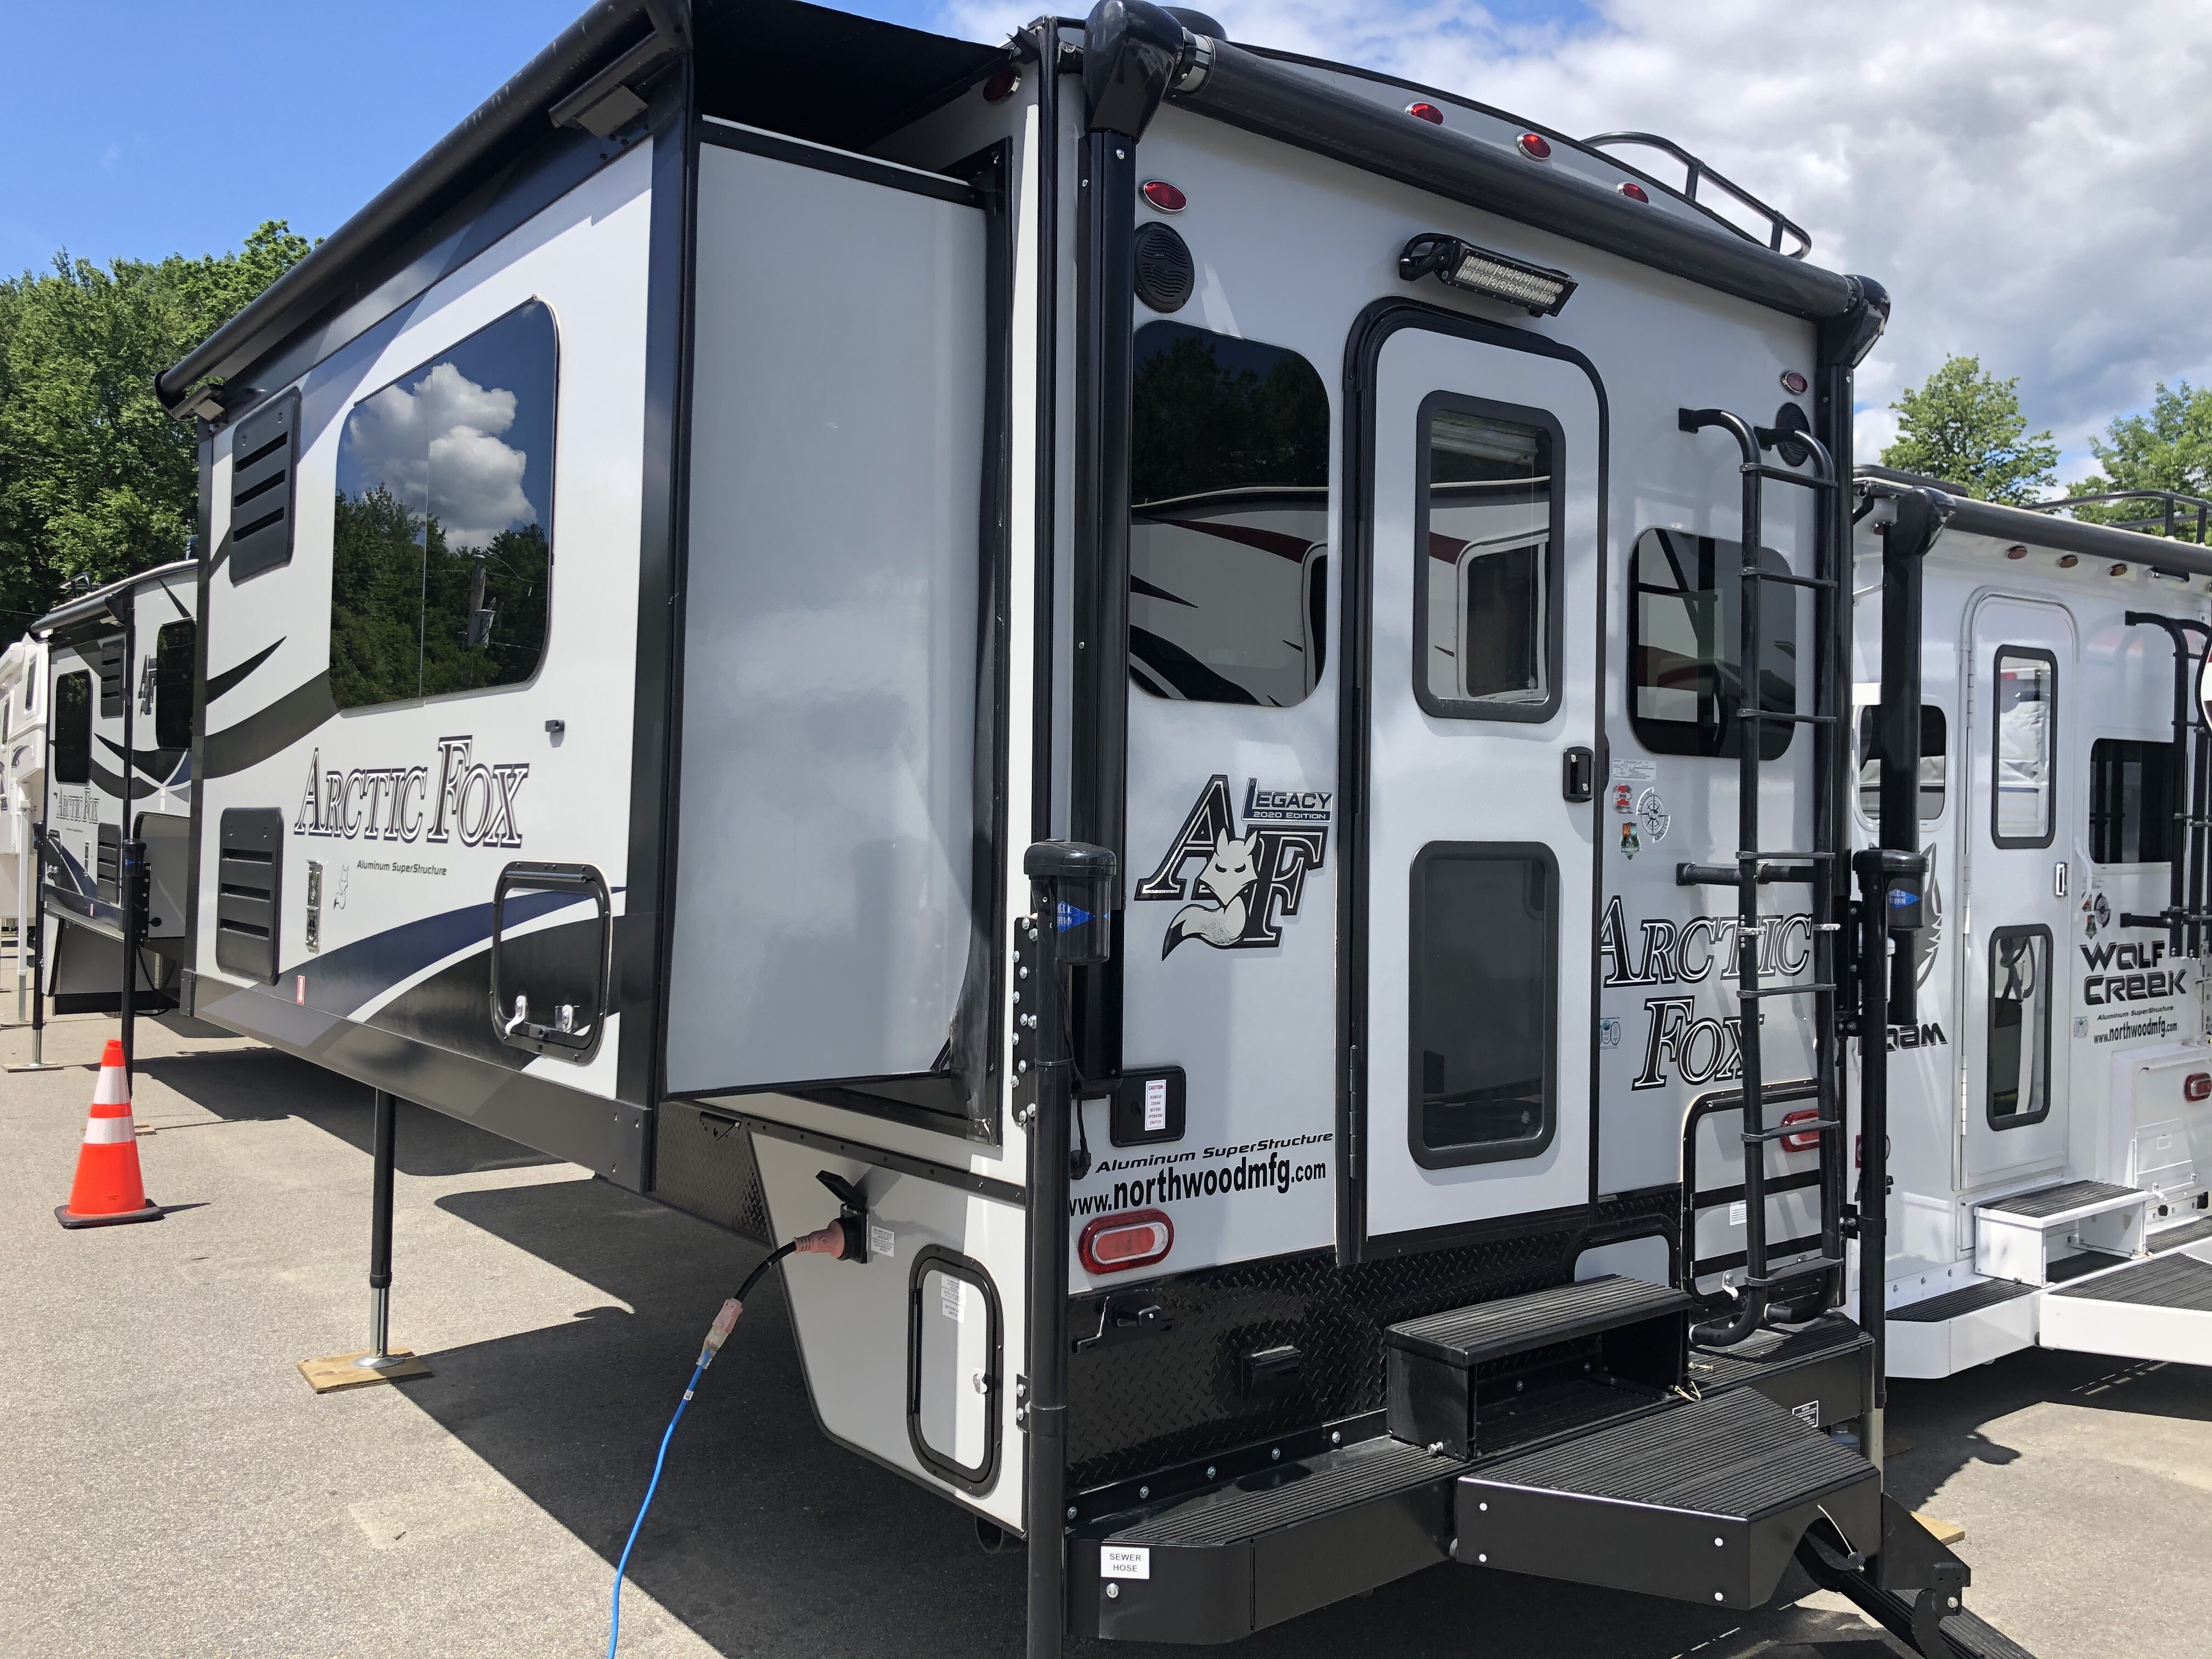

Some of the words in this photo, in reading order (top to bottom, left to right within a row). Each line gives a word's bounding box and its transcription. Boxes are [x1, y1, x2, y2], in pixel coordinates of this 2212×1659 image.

[294, 747, 428, 844] ARCTIC
[426, 735, 530, 849] FOX
[1242, 778, 1333, 810] LEGACY
[357, 860, 390, 871] Aluminum
[392, 862, 448, 876] SuperStructure
[1601, 895, 1813, 988] ARCTIC
[2079, 940, 2165, 973] WOLF
[2093, 1016, 2178, 1044] www.northwoodmfg.com
[2096, 1012, 2129, 1021] Aluminum
[1095, 1152, 1196, 1174] Aluminum
[1202, 1132, 1333, 1159] SuperStructure
[1109, 1553, 1142, 1562] SEWER
